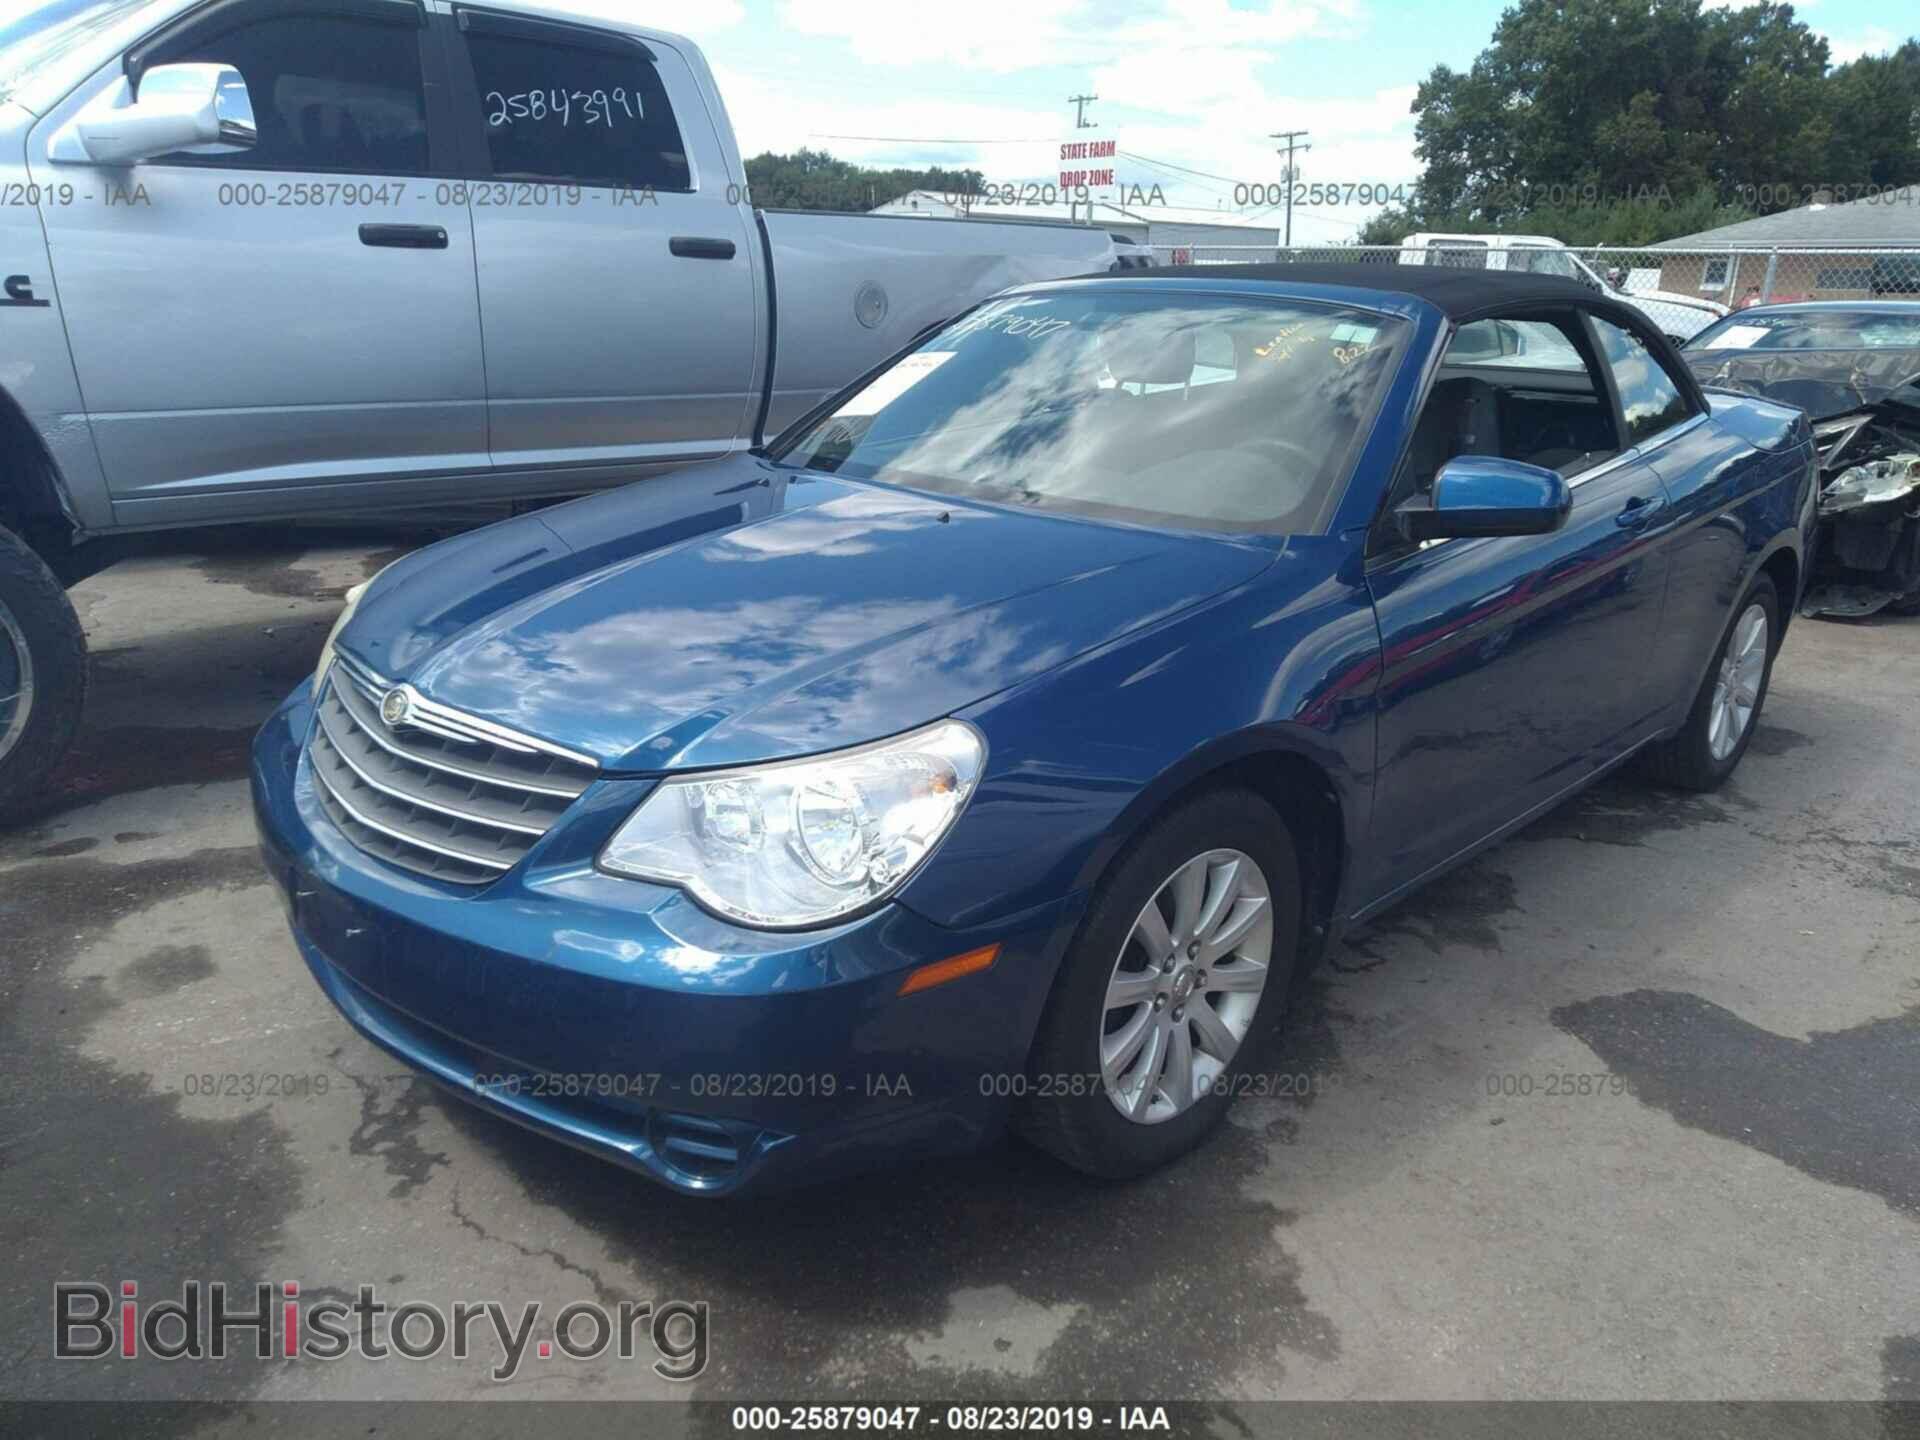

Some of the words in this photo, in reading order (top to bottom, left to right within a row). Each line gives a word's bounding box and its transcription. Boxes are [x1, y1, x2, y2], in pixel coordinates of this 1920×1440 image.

[486, 87, 645, 128] 25843991
[1060, 143, 1087, 160] STATE
[1089, 141, 1115, 157] FARM
[1060, 171, 1087, 188] DROP
[1089, 169, 1113, 186] ZONE
